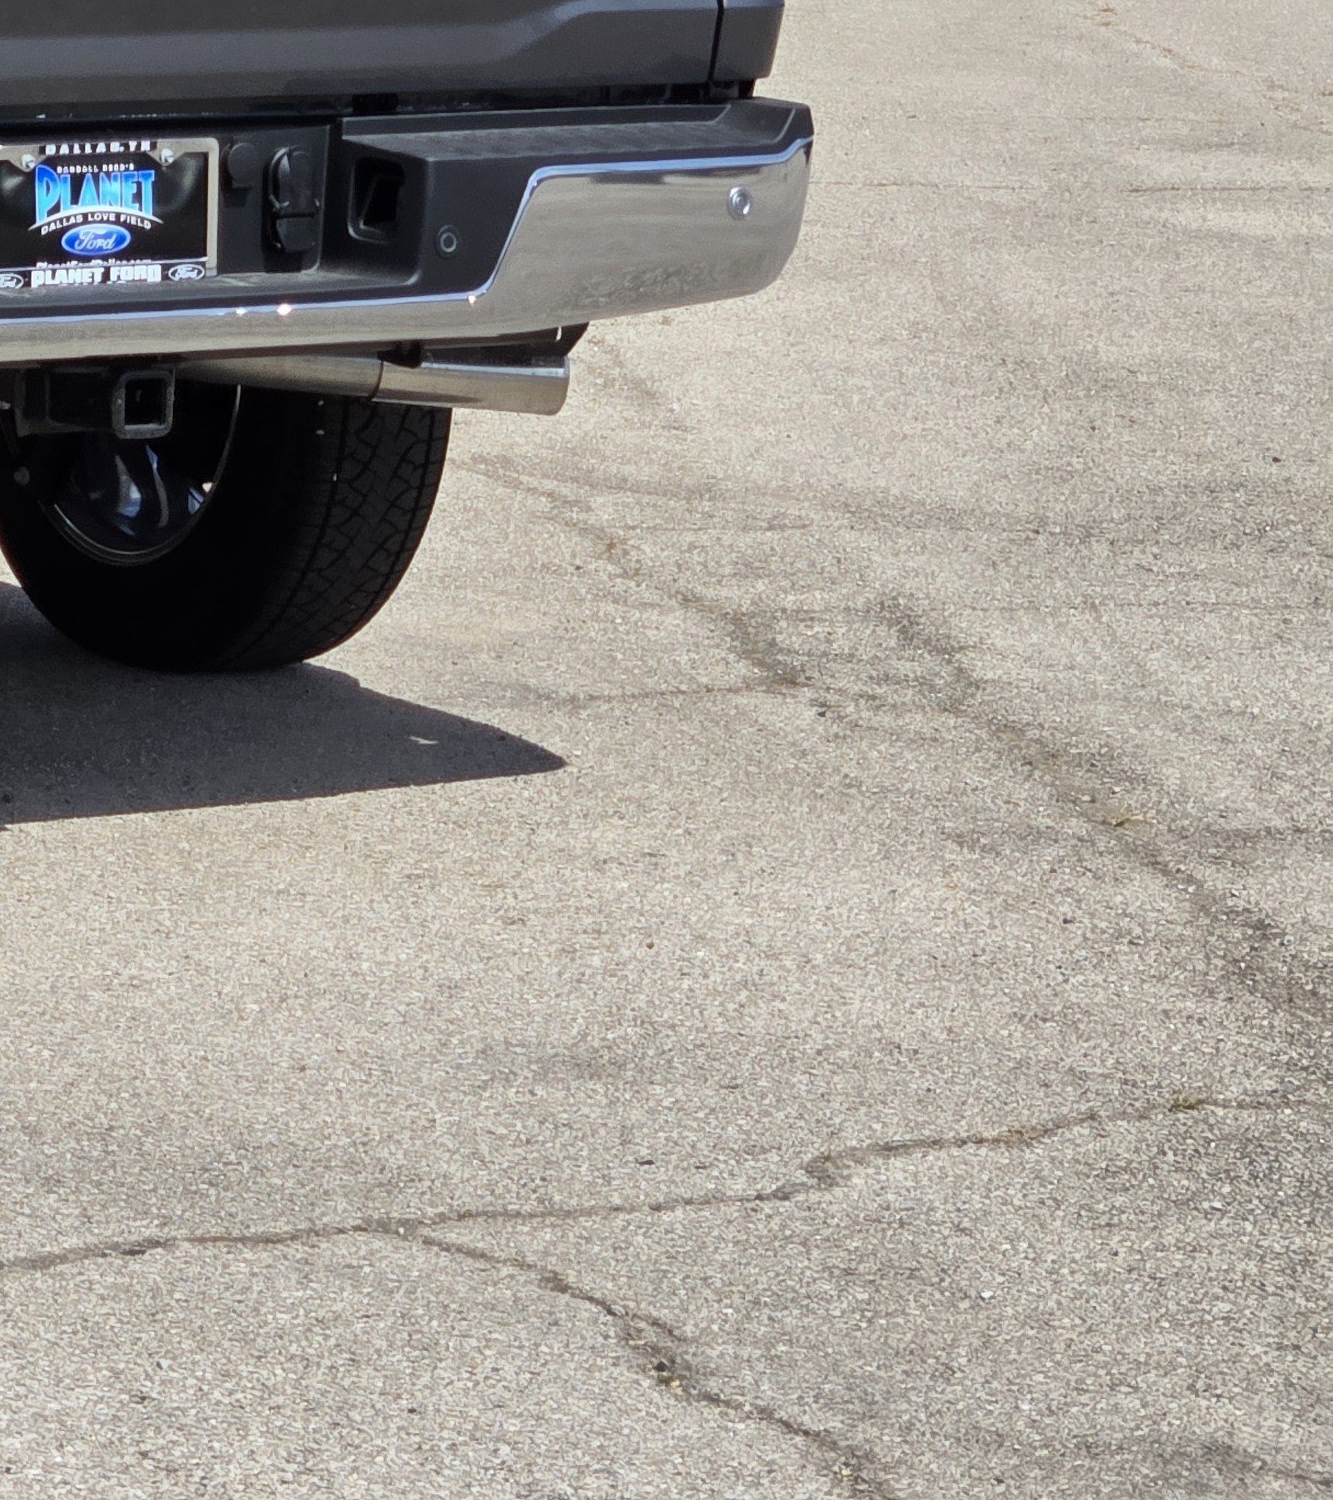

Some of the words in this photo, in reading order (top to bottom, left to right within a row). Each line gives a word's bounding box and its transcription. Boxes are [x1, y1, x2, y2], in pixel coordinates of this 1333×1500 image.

[35, 164, 156, 225] PLANET
[41, 214, 83, 235] DALLAS
[88, 212, 116, 222] LOVE
[120, 214, 152, 230] FIELD
[74, 228, 117, 251] Ford
[31, 267, 104, 288] PLANET
[110, 264, 161, 283] FORD
